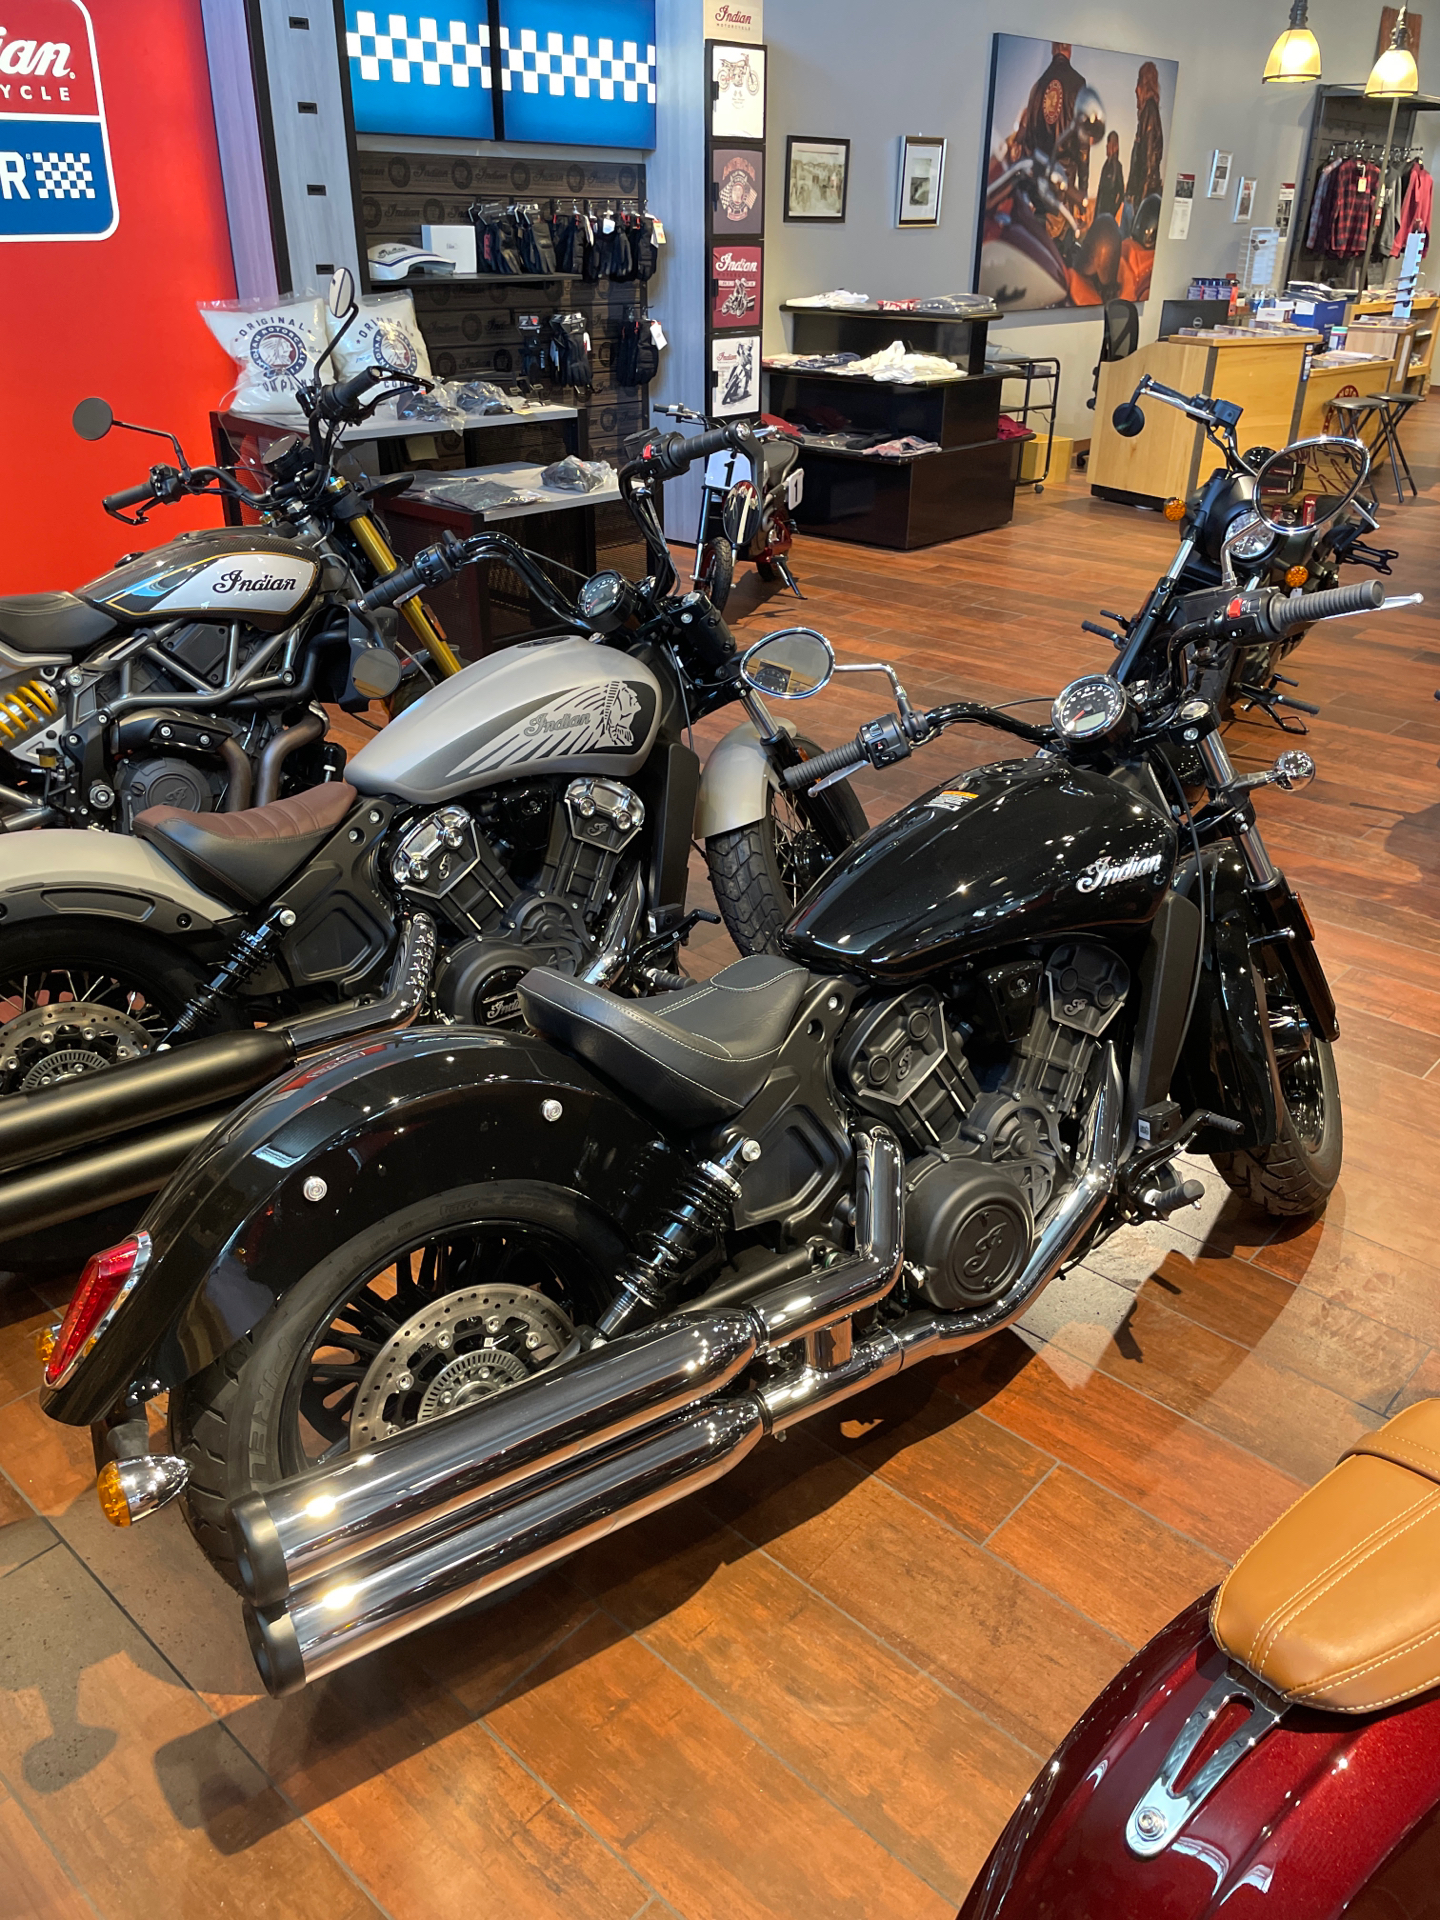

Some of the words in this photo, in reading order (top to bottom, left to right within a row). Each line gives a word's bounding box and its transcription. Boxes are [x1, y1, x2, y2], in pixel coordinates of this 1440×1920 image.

[715, 5, 752, 25] Indian
[715, 252, 758, 272] Indian
[239, 316, 305, 338] ORIGINAL
[212, 569, 297, 594] Indian
[523, 712, 591, 737] Indian
[1076, 854, 1163, 894] Indian
